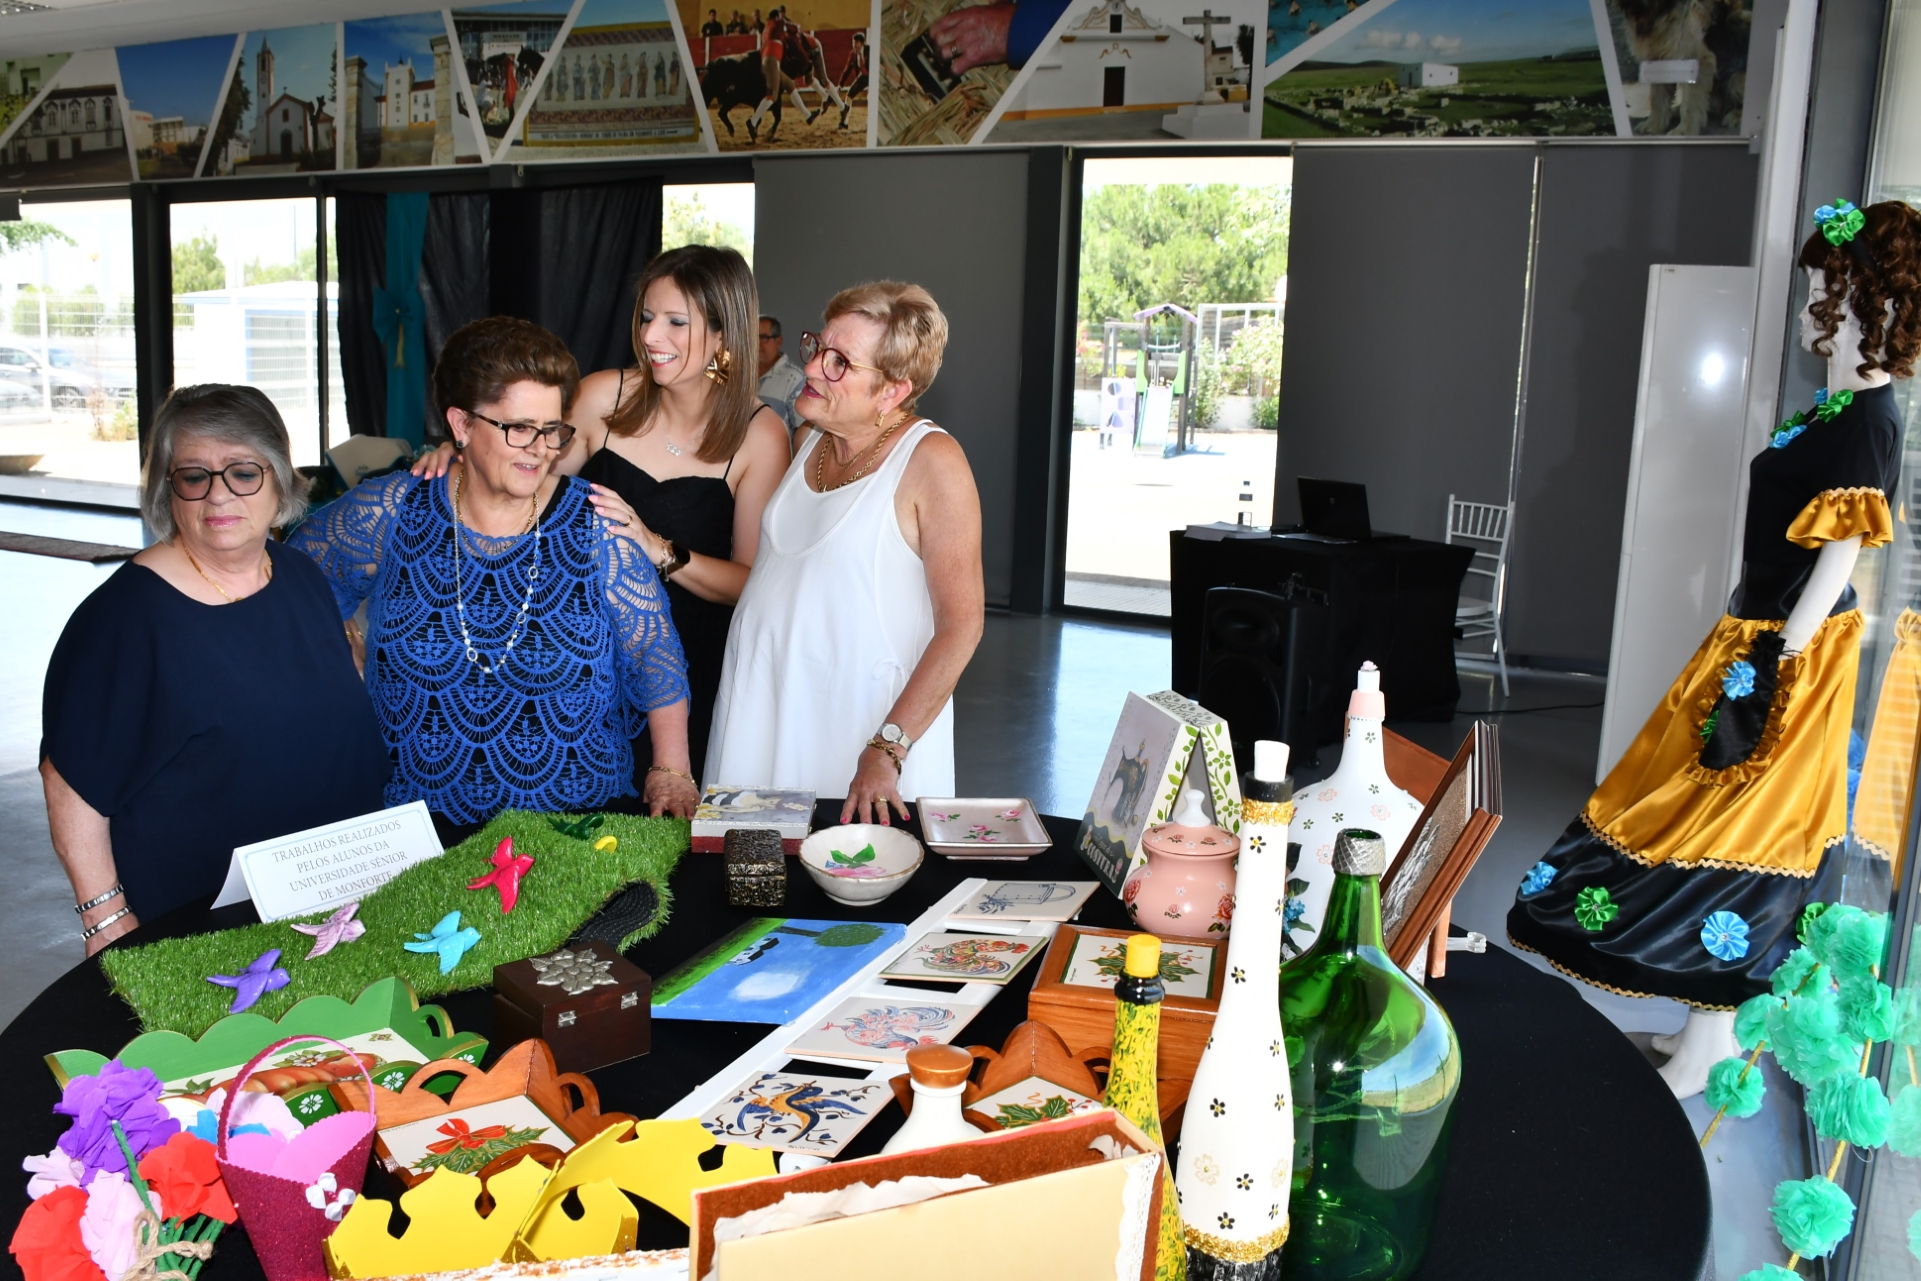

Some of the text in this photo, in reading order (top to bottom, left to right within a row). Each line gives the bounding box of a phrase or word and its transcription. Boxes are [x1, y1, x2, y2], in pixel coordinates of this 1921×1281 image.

[272, 820, 401, 862] TRABALHOS REALIZADOS
[297, 840, 390, 873] PELOS ALUNOS DA
[289, 850, 408, 892] UNIVERSIDADE SÉNIOR
[318, 870, 393, 901] DE MONFORTE
